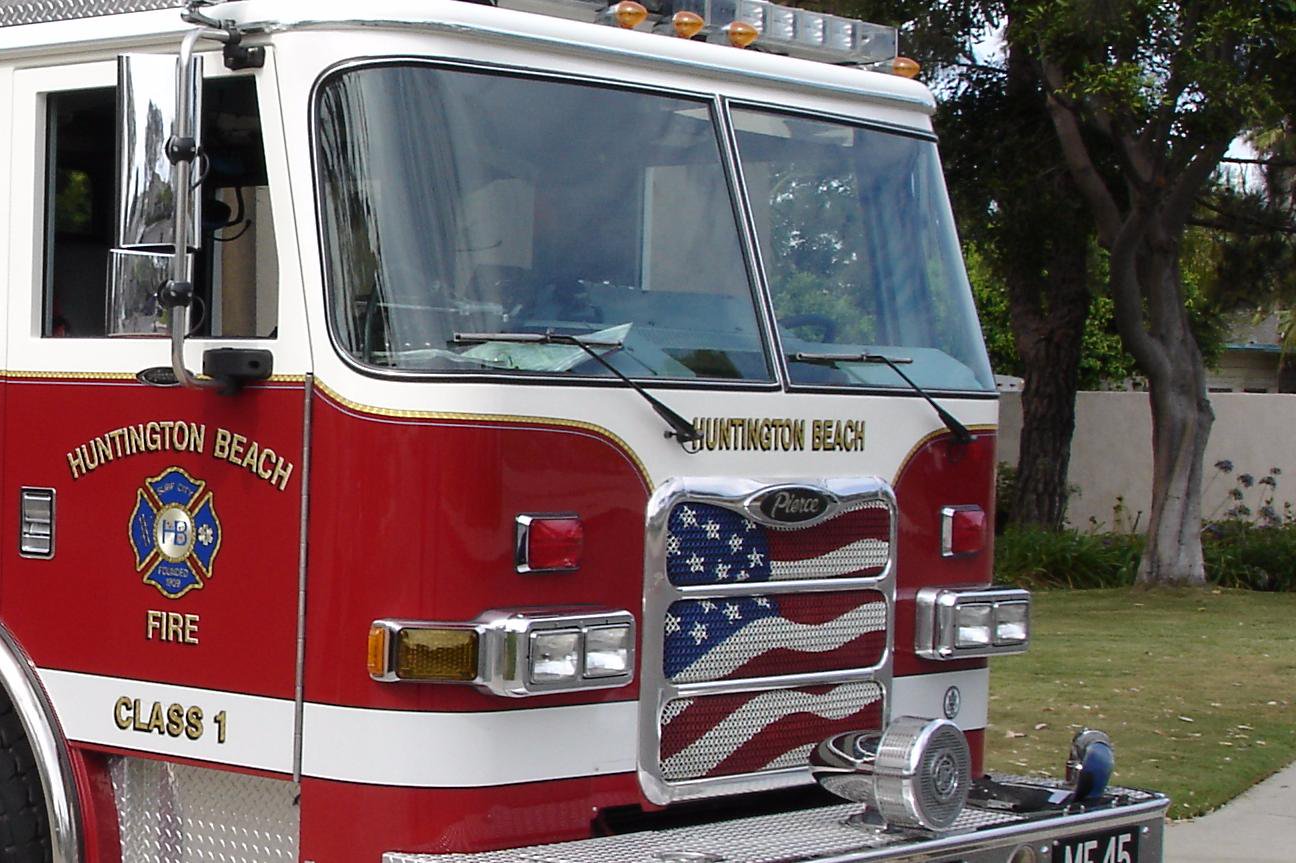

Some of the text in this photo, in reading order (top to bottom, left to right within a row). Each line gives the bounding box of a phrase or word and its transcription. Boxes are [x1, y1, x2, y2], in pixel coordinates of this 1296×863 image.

[692, 416, 866, 452] HUNTINGTON BEACH
[66, 420, 294, 492] HUNTINGTON BEACH
[770, 491, 820, 519] Pierce
[161, 519, 188, 546] HB
[146, 609, 200, 645] FIRE
[113, 696, 227, 744] CLASS 1
